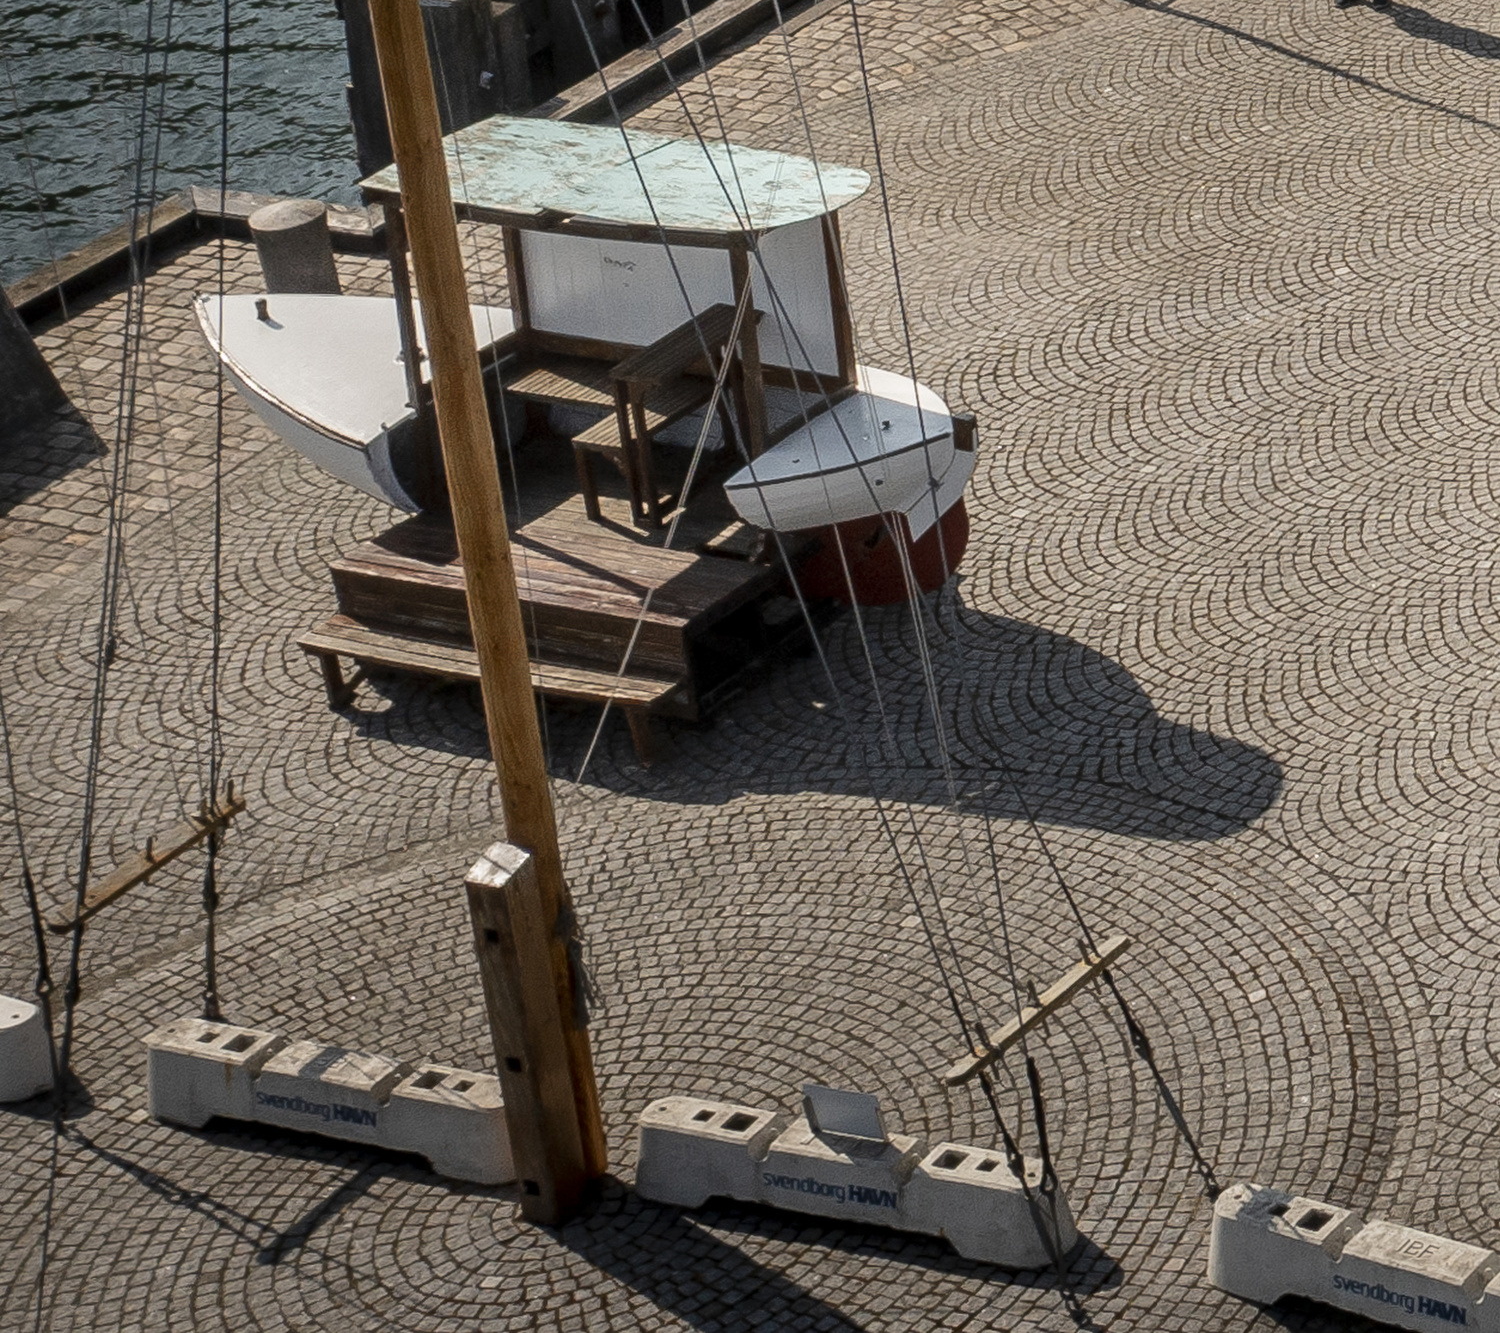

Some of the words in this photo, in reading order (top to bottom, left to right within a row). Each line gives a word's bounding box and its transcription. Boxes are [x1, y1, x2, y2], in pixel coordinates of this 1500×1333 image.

[256, 1091, 331, 1122] svendborg
[332, 1103, 377, 1128] HAVN
[762, 1172, 846, 1204] svendborg
[849, 1184, 898, 1208] HAVN
[1396, 1238, 1440, 1258] IBF
[1333, 1274, 1415, 1314] svendborg
[1416, 1295, 1468, 1325] HAVN
